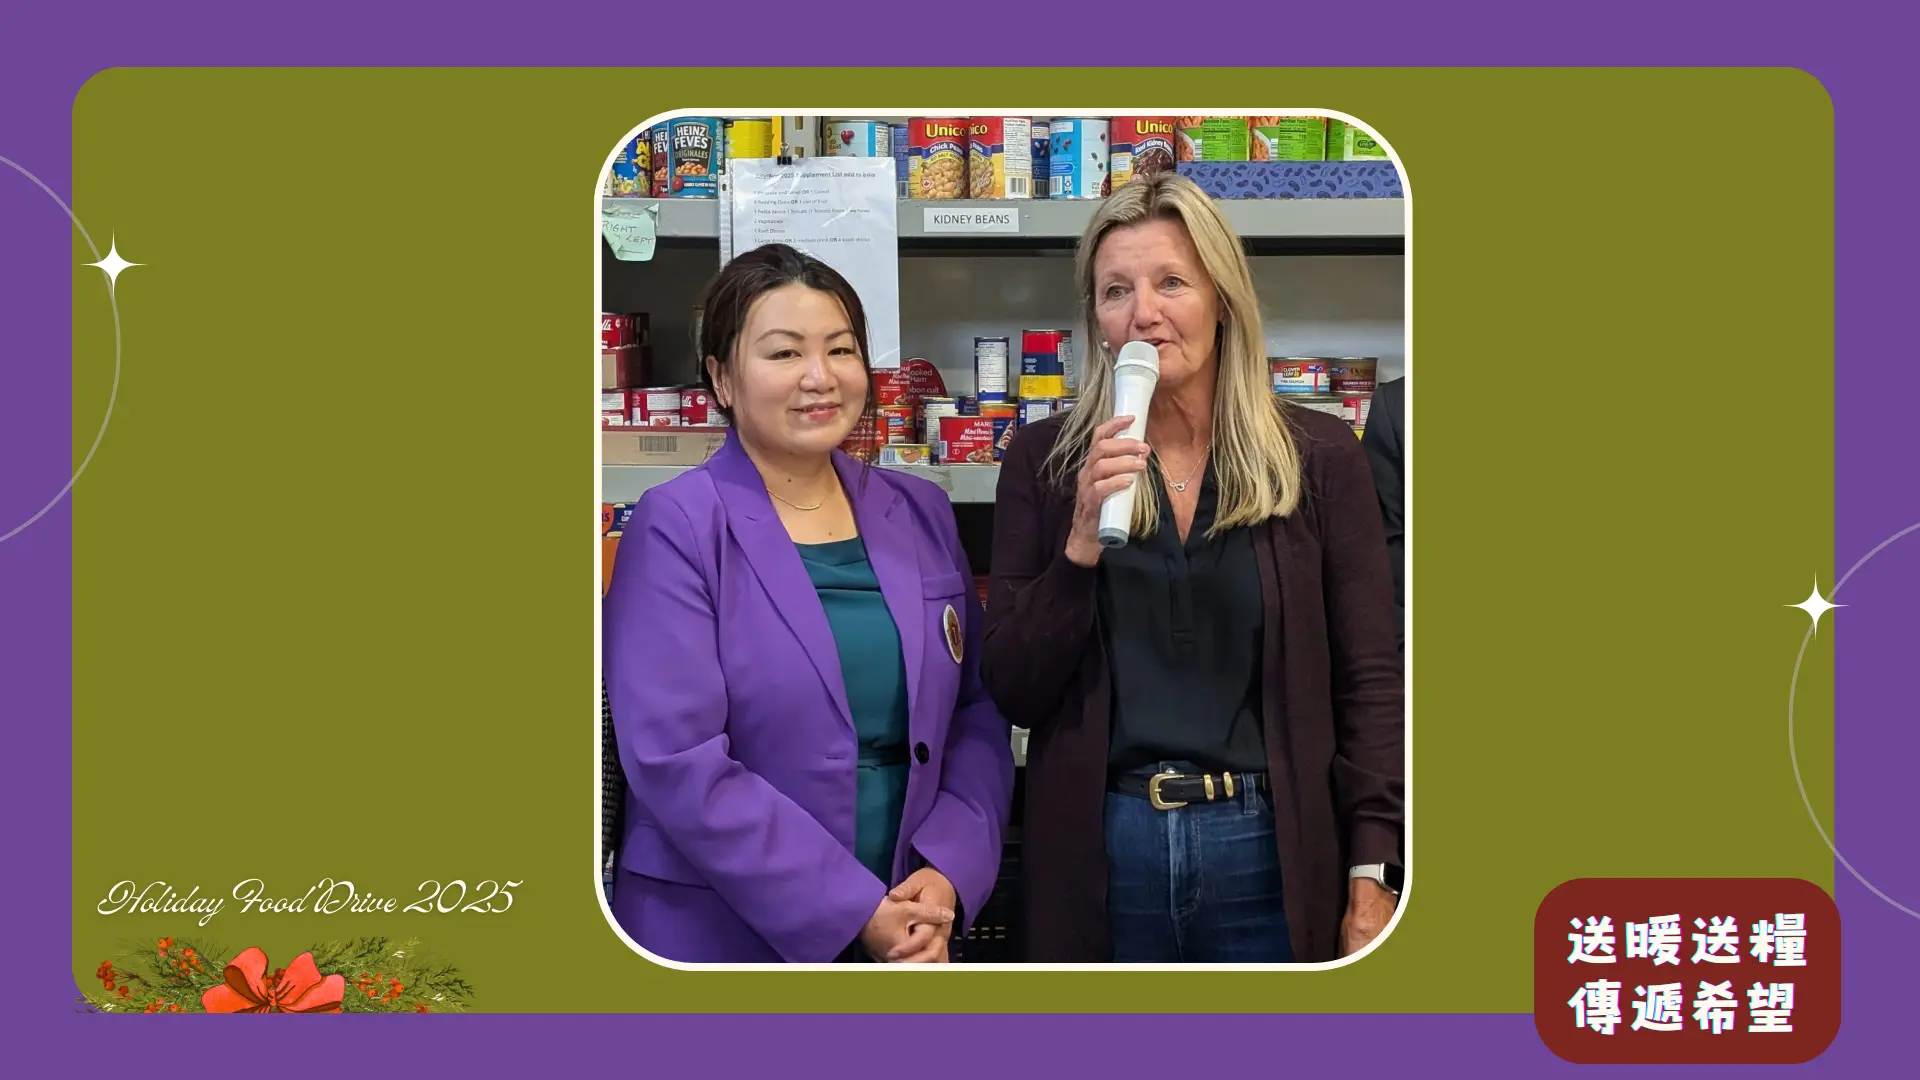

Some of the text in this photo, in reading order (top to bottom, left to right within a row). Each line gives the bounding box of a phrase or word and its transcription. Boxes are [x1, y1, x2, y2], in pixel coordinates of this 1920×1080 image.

[677, 126, 706, 137] HEINZ
[926, 123, 966, 138] Unico
[1136, 120, 1173, 134] Unico
[674, 137, 708, 149] FEVES
[929, 143, 948, 154] Chick
[1146, 139, 1163, 148] Kidney
[675, 149, 708, 159] ORIGINALES
[933, 215, 1010, 224] KIDNEY BEANS
[602, 220, 638, 233] RIGHT
